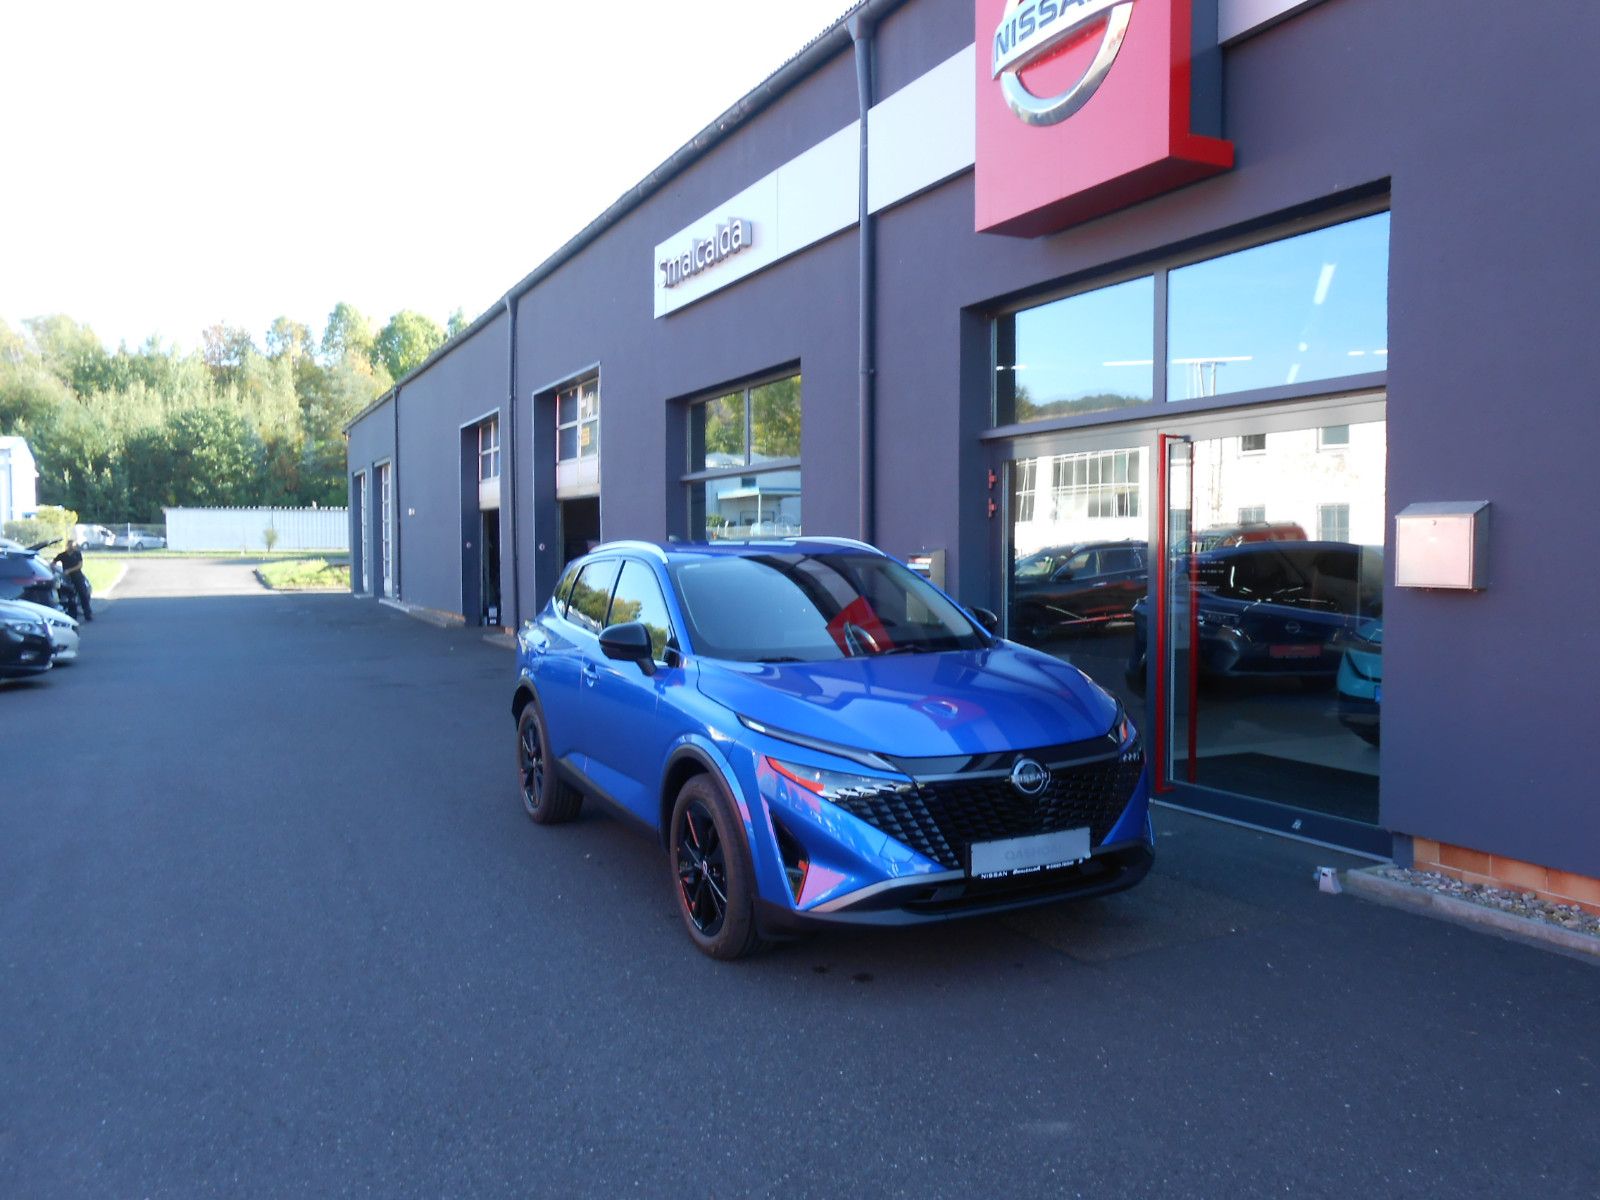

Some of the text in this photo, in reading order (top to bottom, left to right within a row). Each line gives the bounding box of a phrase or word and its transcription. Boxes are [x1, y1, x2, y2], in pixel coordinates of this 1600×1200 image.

[995, 0, 1092, 62] NISS
[658, 217, 752, 288] Smalcalda
[981, 870, 1008, 879] NISSAN
